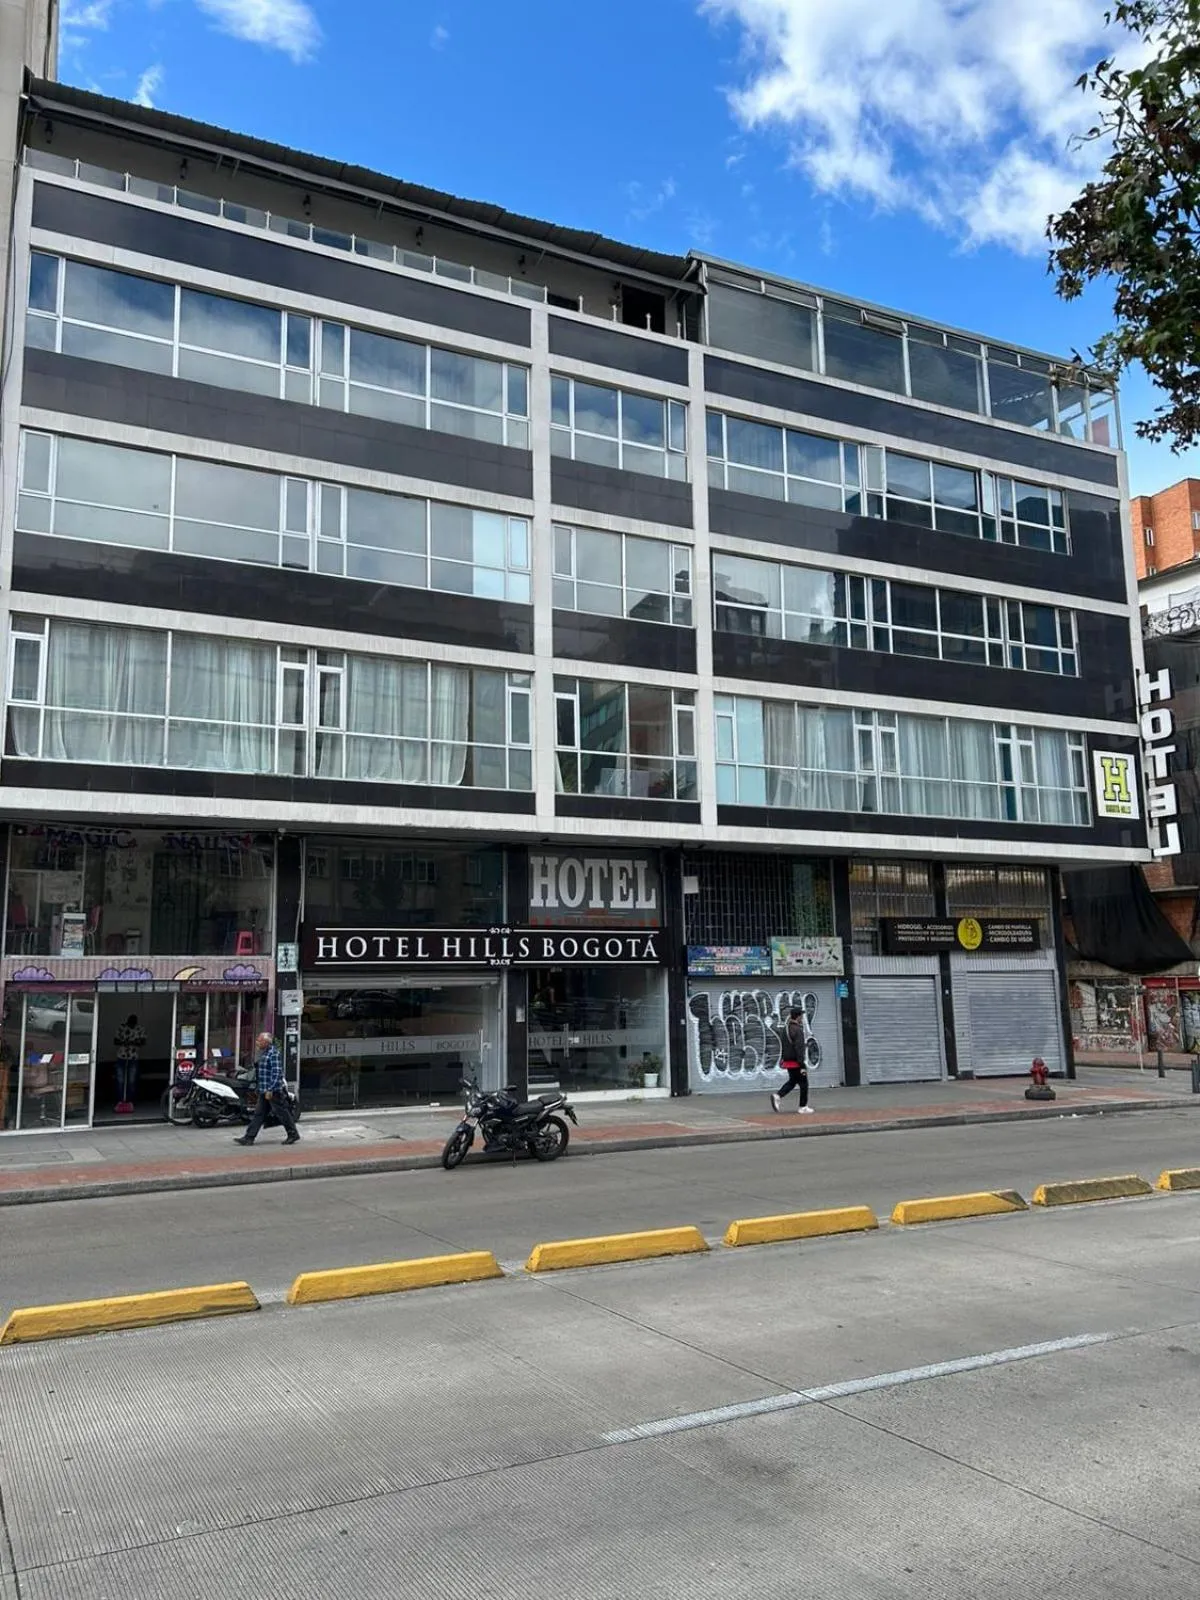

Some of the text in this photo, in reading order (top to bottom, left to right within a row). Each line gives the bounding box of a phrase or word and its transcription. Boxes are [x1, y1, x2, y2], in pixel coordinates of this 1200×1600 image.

[1101, 756, 1131, 802] H
[530, 856, 657, 909] HOTEL
[317, 936, 430, 958] HOTEL
[442, 936, 530, 958] HILLS
[542, 934, 658, 958] BOGOTÁ
